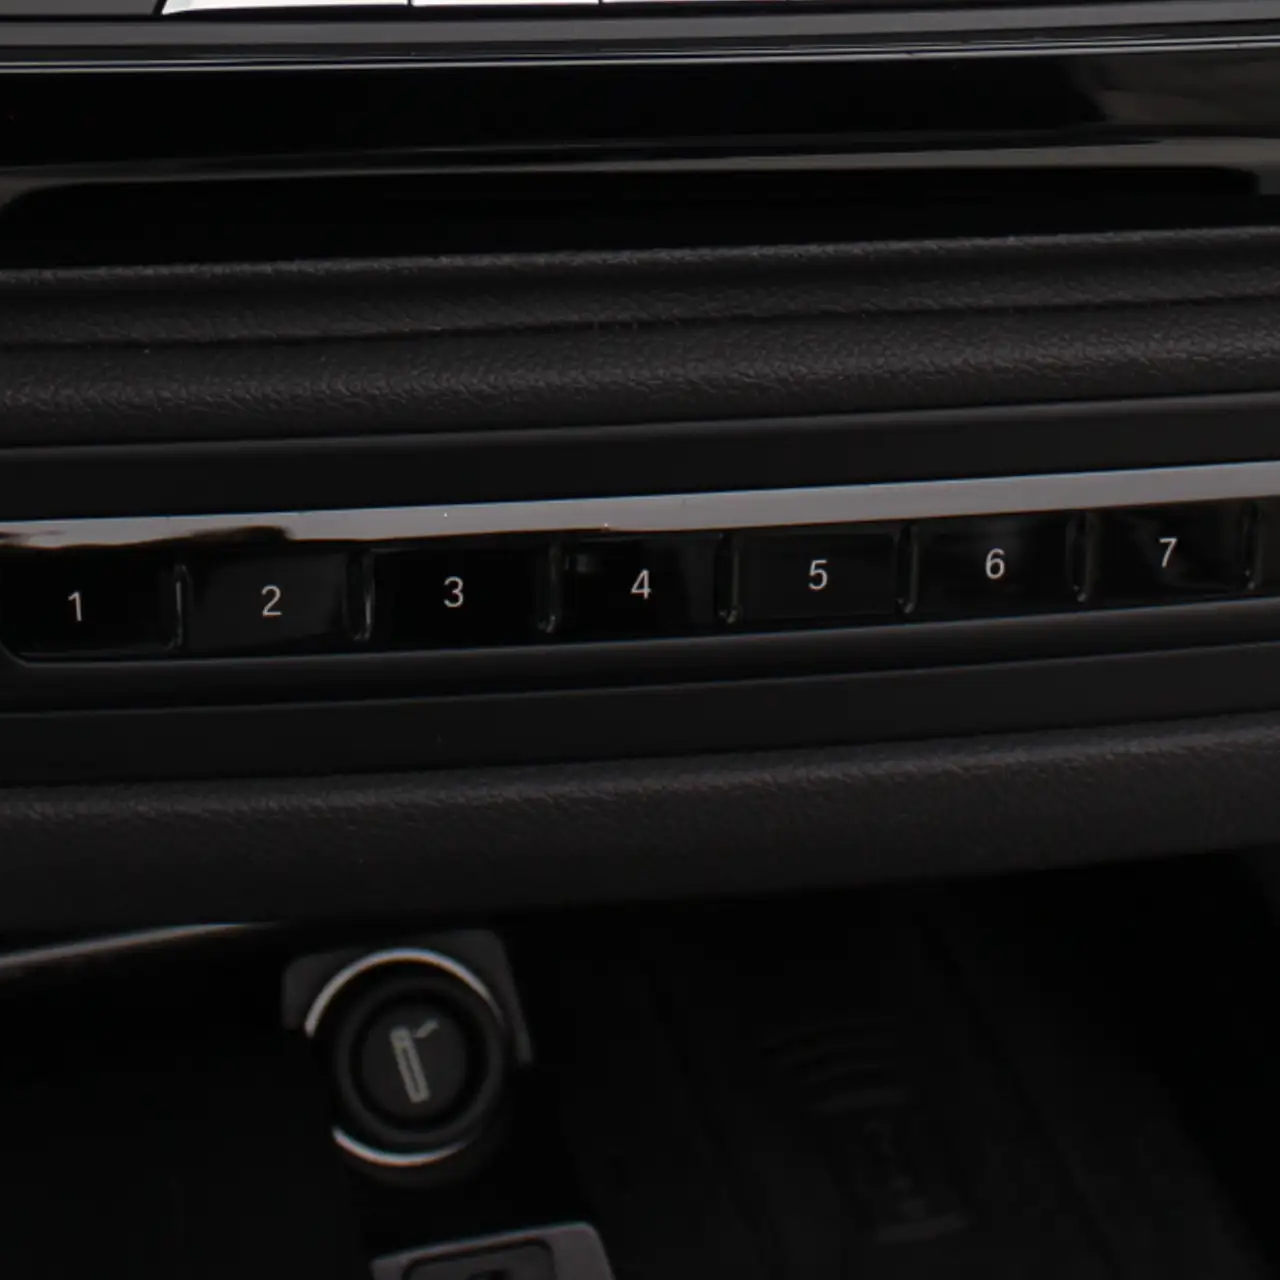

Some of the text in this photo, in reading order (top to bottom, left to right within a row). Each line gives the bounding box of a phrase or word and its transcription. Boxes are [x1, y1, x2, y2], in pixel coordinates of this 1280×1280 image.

[985, 547, 1005, 580] 6
[1159, 537, 1178, 568] 7
[630, 569, 652, 599] 4
[809, 559, 828, 591] 5
[67, 591, 82, 622] 1
[261, 585, 282, 617] 2
[443, 576, 464, 608] 3
